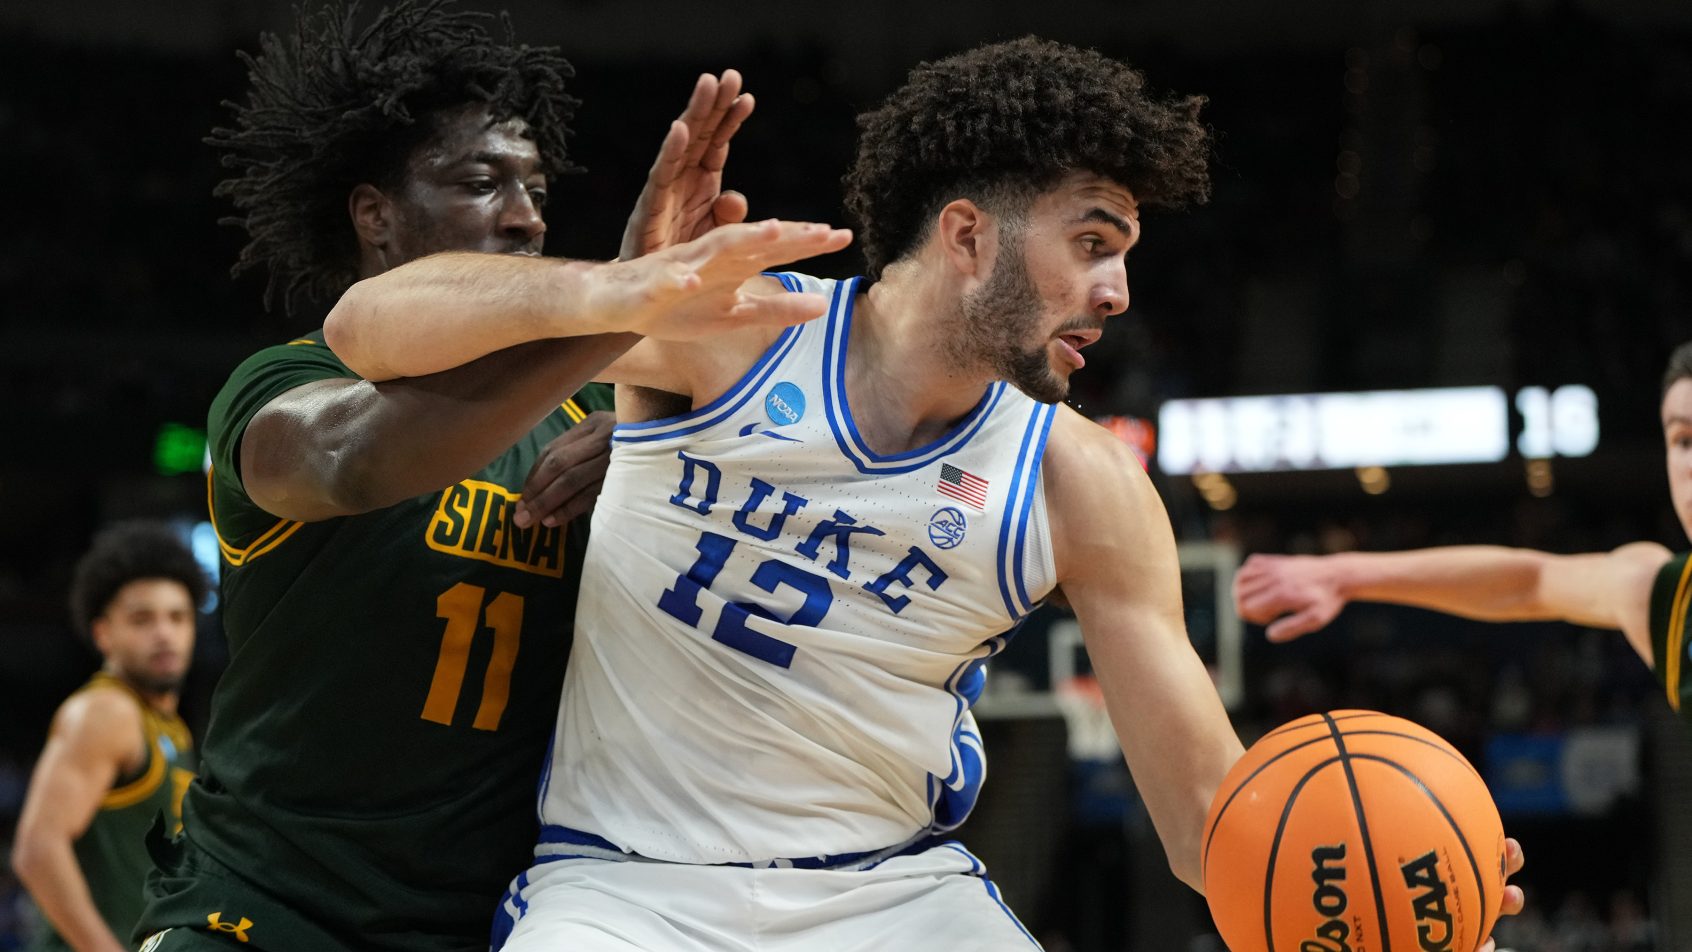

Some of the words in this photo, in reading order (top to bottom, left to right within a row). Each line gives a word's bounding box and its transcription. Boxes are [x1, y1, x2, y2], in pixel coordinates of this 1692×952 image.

[769, 393, 799, 424] NCAA
[657, 531, 834, 669] 12
[669, 450, 949, 614] DUKE
[421, 582, 524, 731] 11
[1401, 850, 1454, 952] CAA
